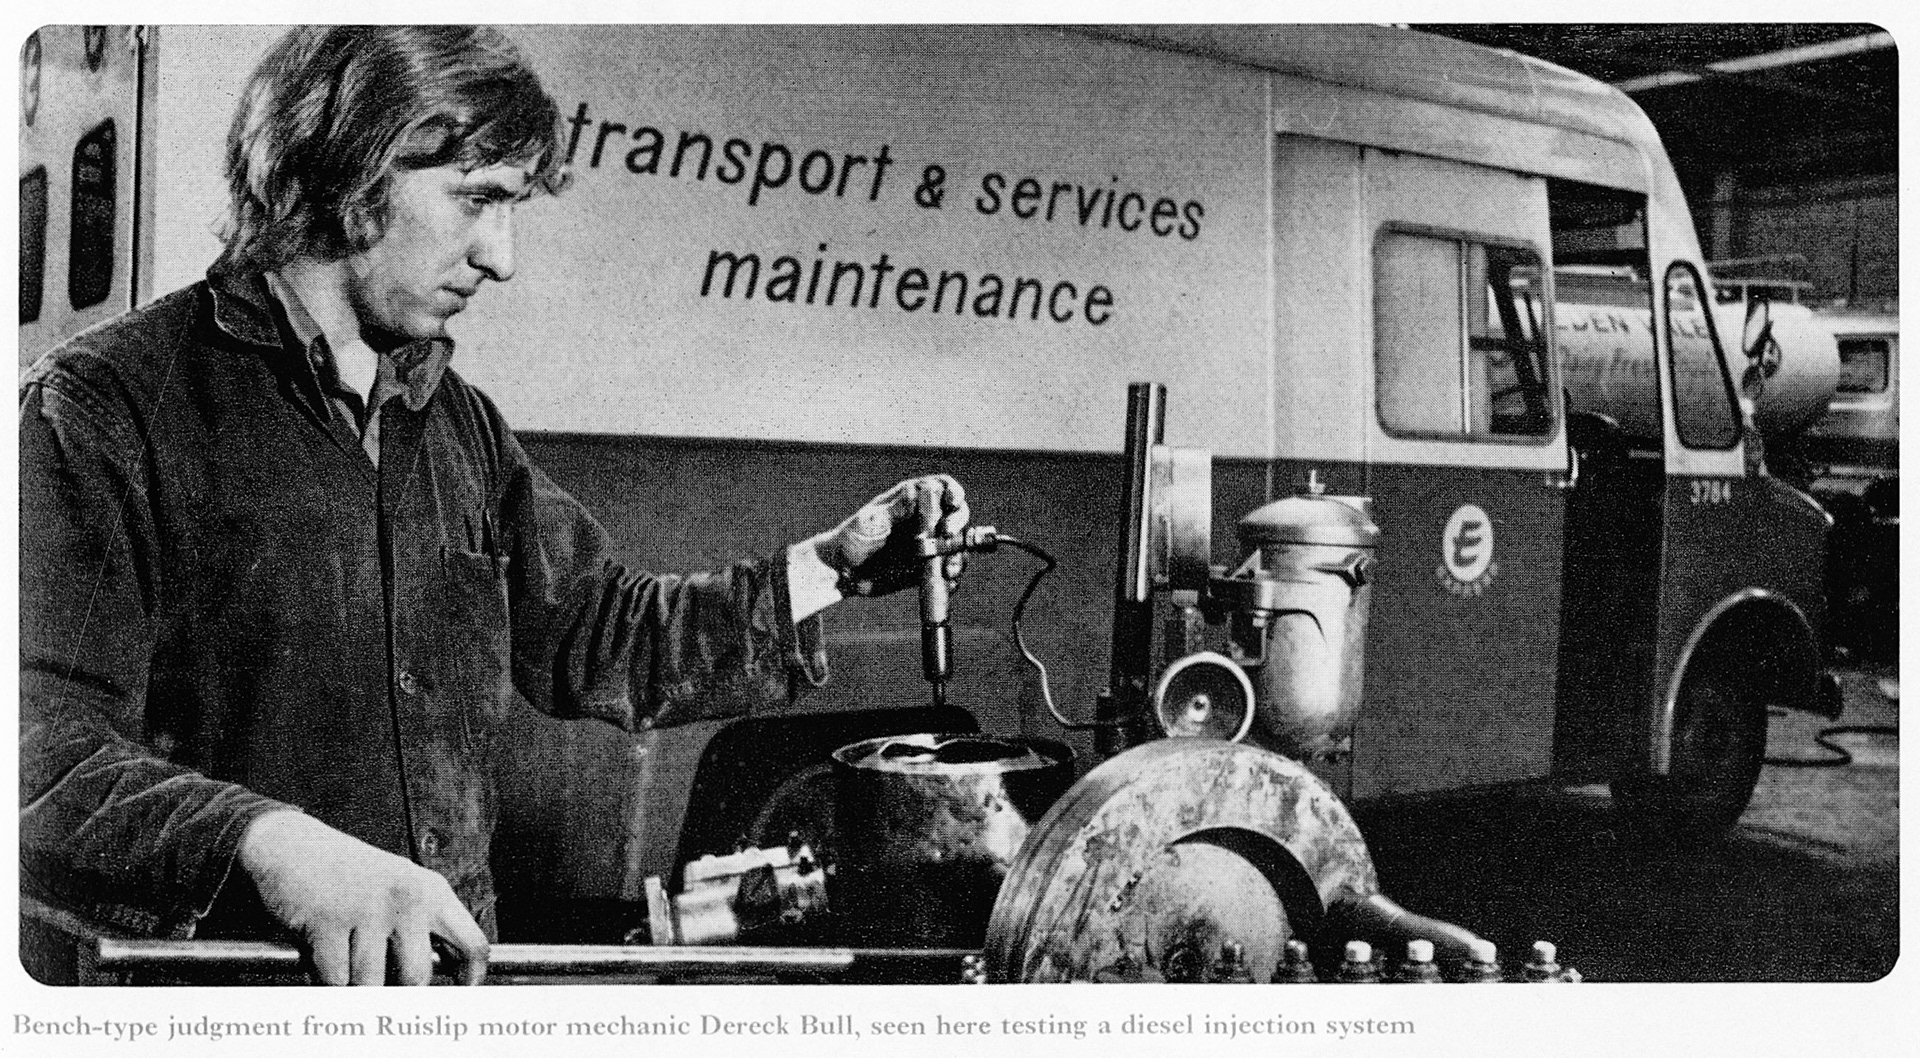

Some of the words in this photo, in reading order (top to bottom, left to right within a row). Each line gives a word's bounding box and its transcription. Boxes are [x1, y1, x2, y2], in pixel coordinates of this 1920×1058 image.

[565, 102, 893, 206] transport
[914, 164, 946, 209] &
[976, 175, 1205, 241] services
[700, 242, 1115, 326] maintenance
